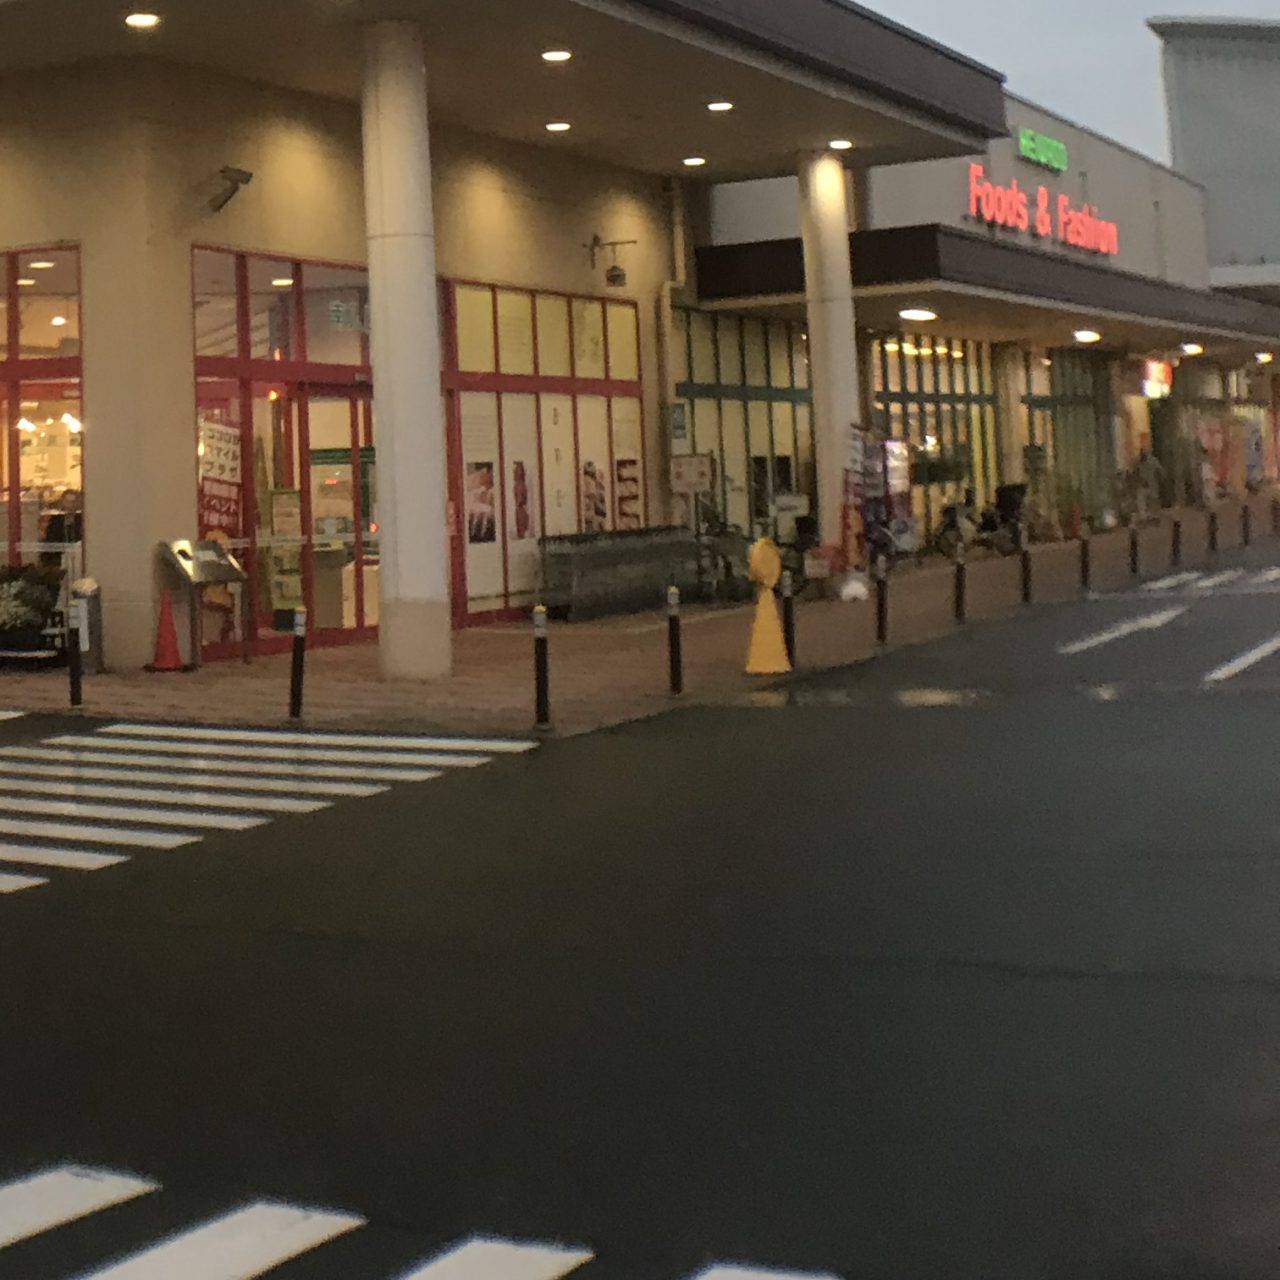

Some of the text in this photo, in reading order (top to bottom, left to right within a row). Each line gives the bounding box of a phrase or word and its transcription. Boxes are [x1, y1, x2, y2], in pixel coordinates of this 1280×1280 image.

[969, 163, 1119, 255] Foods & Fashion
